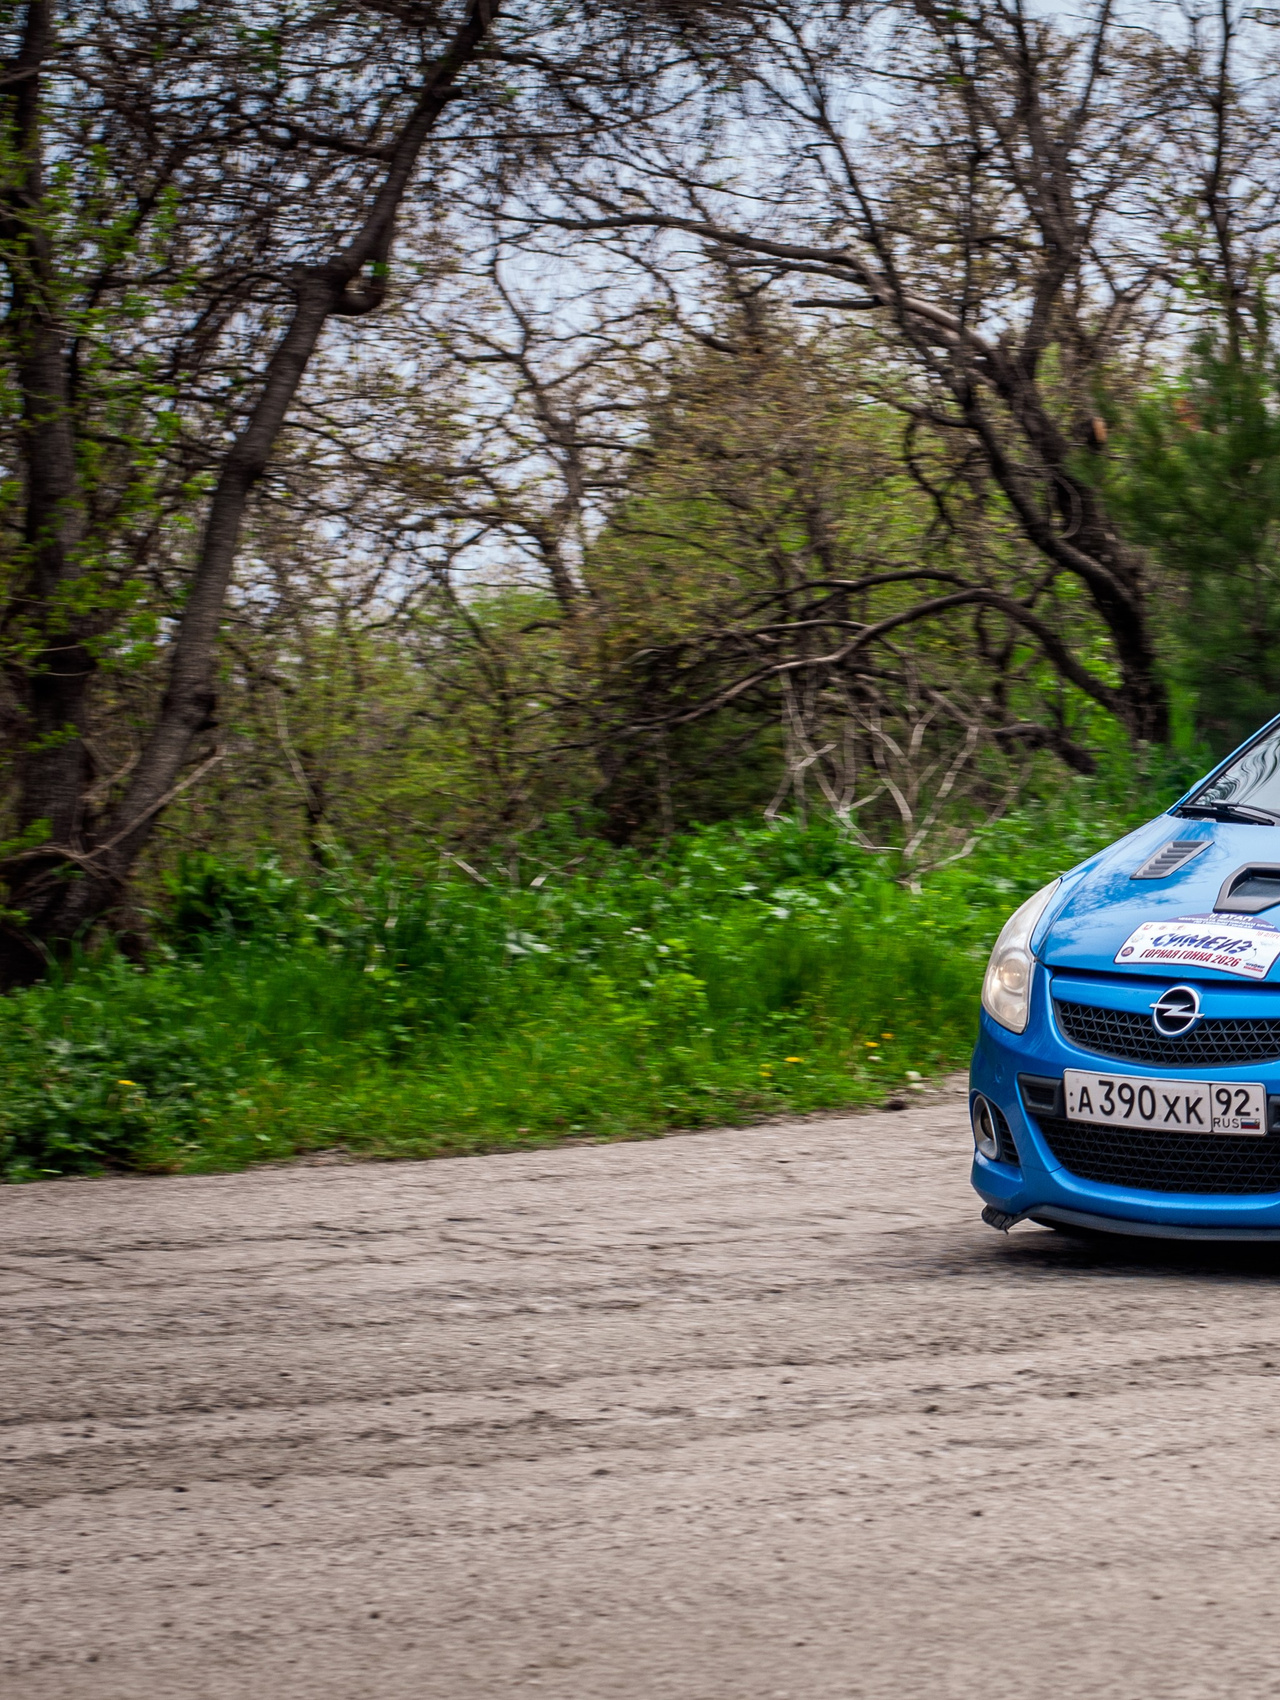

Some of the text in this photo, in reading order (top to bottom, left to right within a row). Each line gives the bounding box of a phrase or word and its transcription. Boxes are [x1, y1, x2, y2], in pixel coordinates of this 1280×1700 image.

[1153, 933, 1253, 954] СИМЕИЗ
[1139, 948, 1242, 967] ГОРНАЯ ГОНКА 2026
[1215, 1088, 1251, 1117] 92
[1213, 1117, 1240, 1129] RUS
